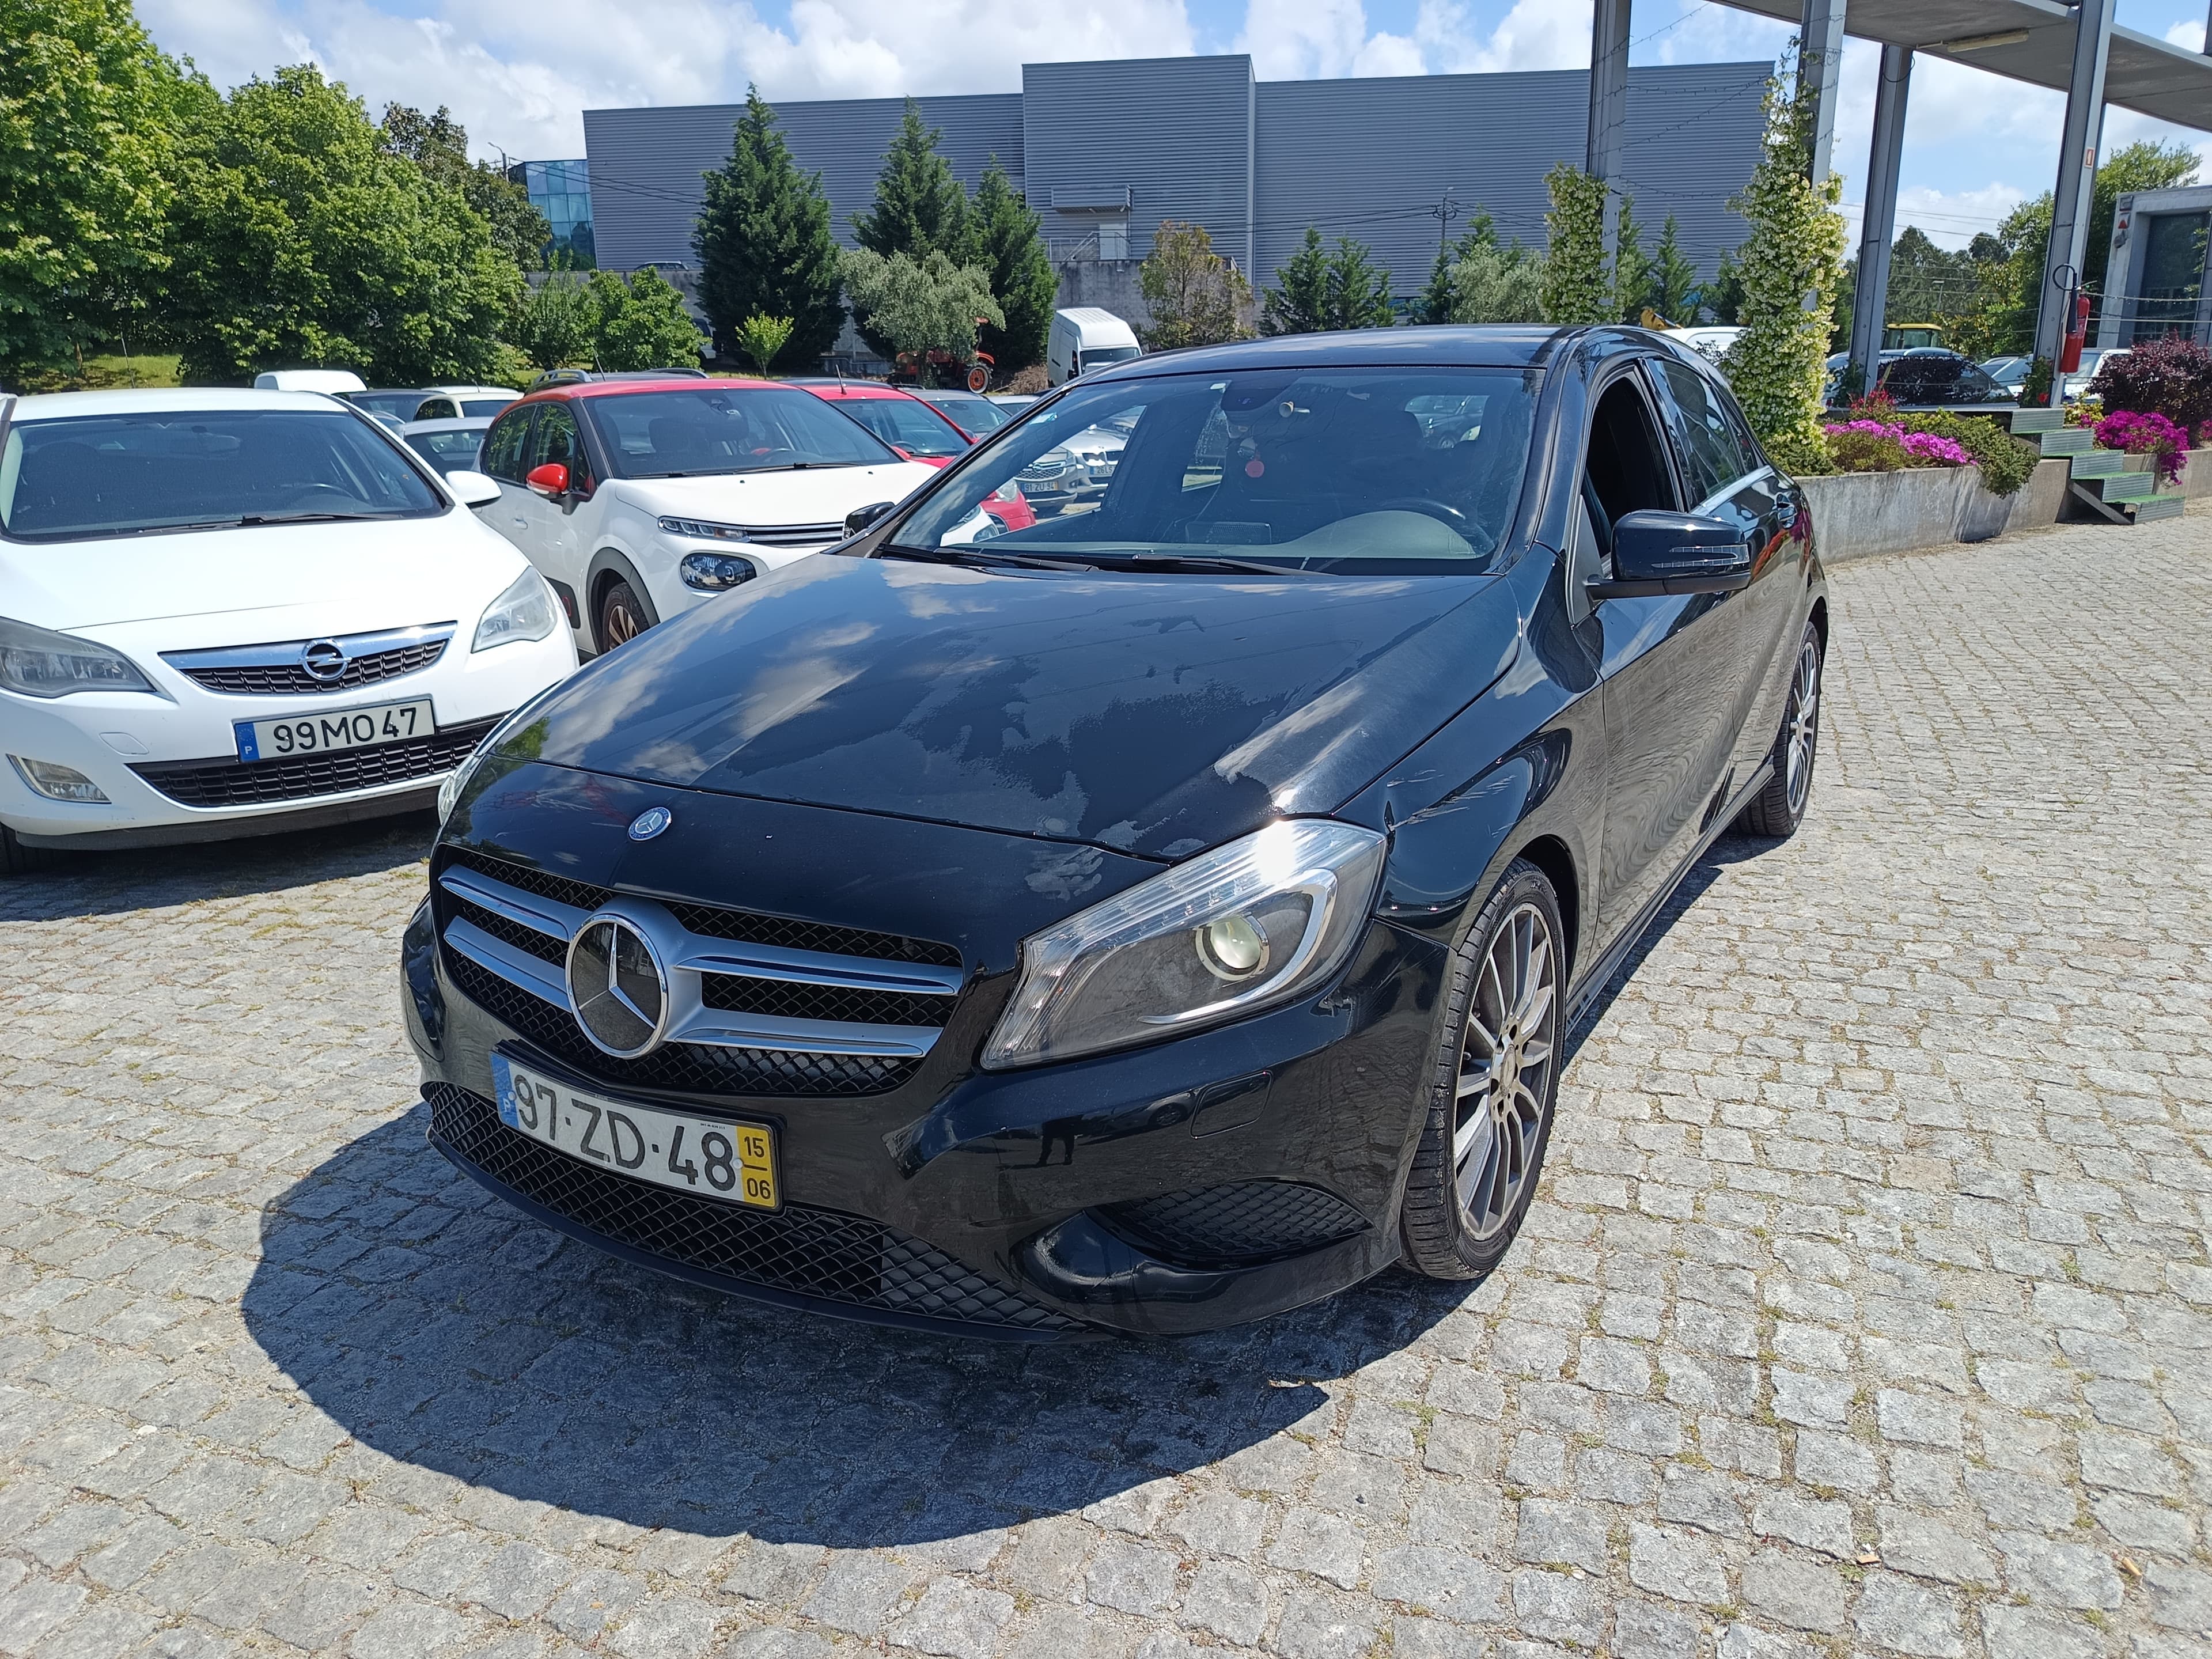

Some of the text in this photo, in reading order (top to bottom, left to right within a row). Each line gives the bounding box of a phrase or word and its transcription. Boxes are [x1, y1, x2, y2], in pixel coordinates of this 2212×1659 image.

[245, 746, 252, 754] P
[503, 1097, 511, 1112] P
[744, 1136, 765, 1158] 15
[747, 1177, 771, 1199] 06
